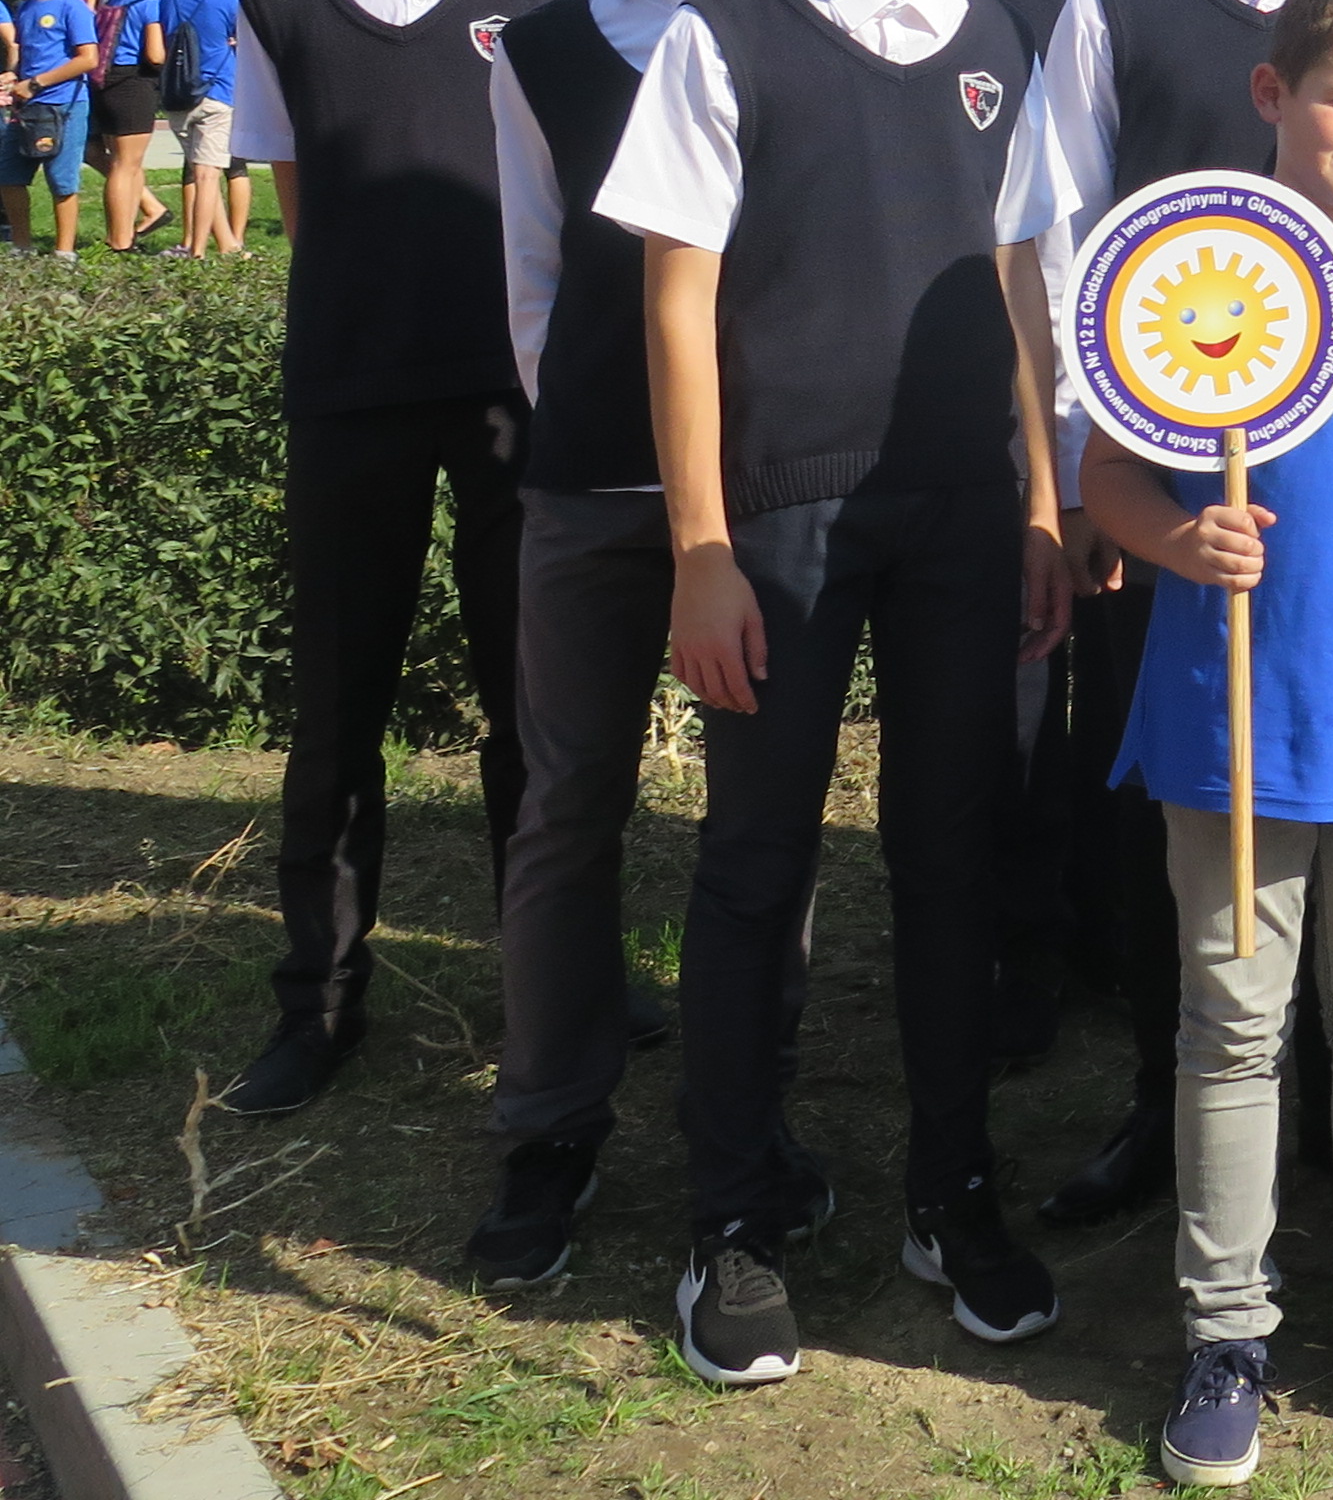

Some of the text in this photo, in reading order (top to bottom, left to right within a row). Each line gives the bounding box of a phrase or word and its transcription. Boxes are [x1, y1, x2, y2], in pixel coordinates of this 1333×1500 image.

[1231, 194, 1245, 207] w
[1120, 190, 1228, 240] Integracyjnymi
[1082, 317, 1095, 326] z
[1079, 329, 1096, 348] 12
[1083, 350, 1102, 370] Nr
[1093, 369, 1166, 443] Podstawowa
[1248, 394, 1318, 443] Uśmiechu
